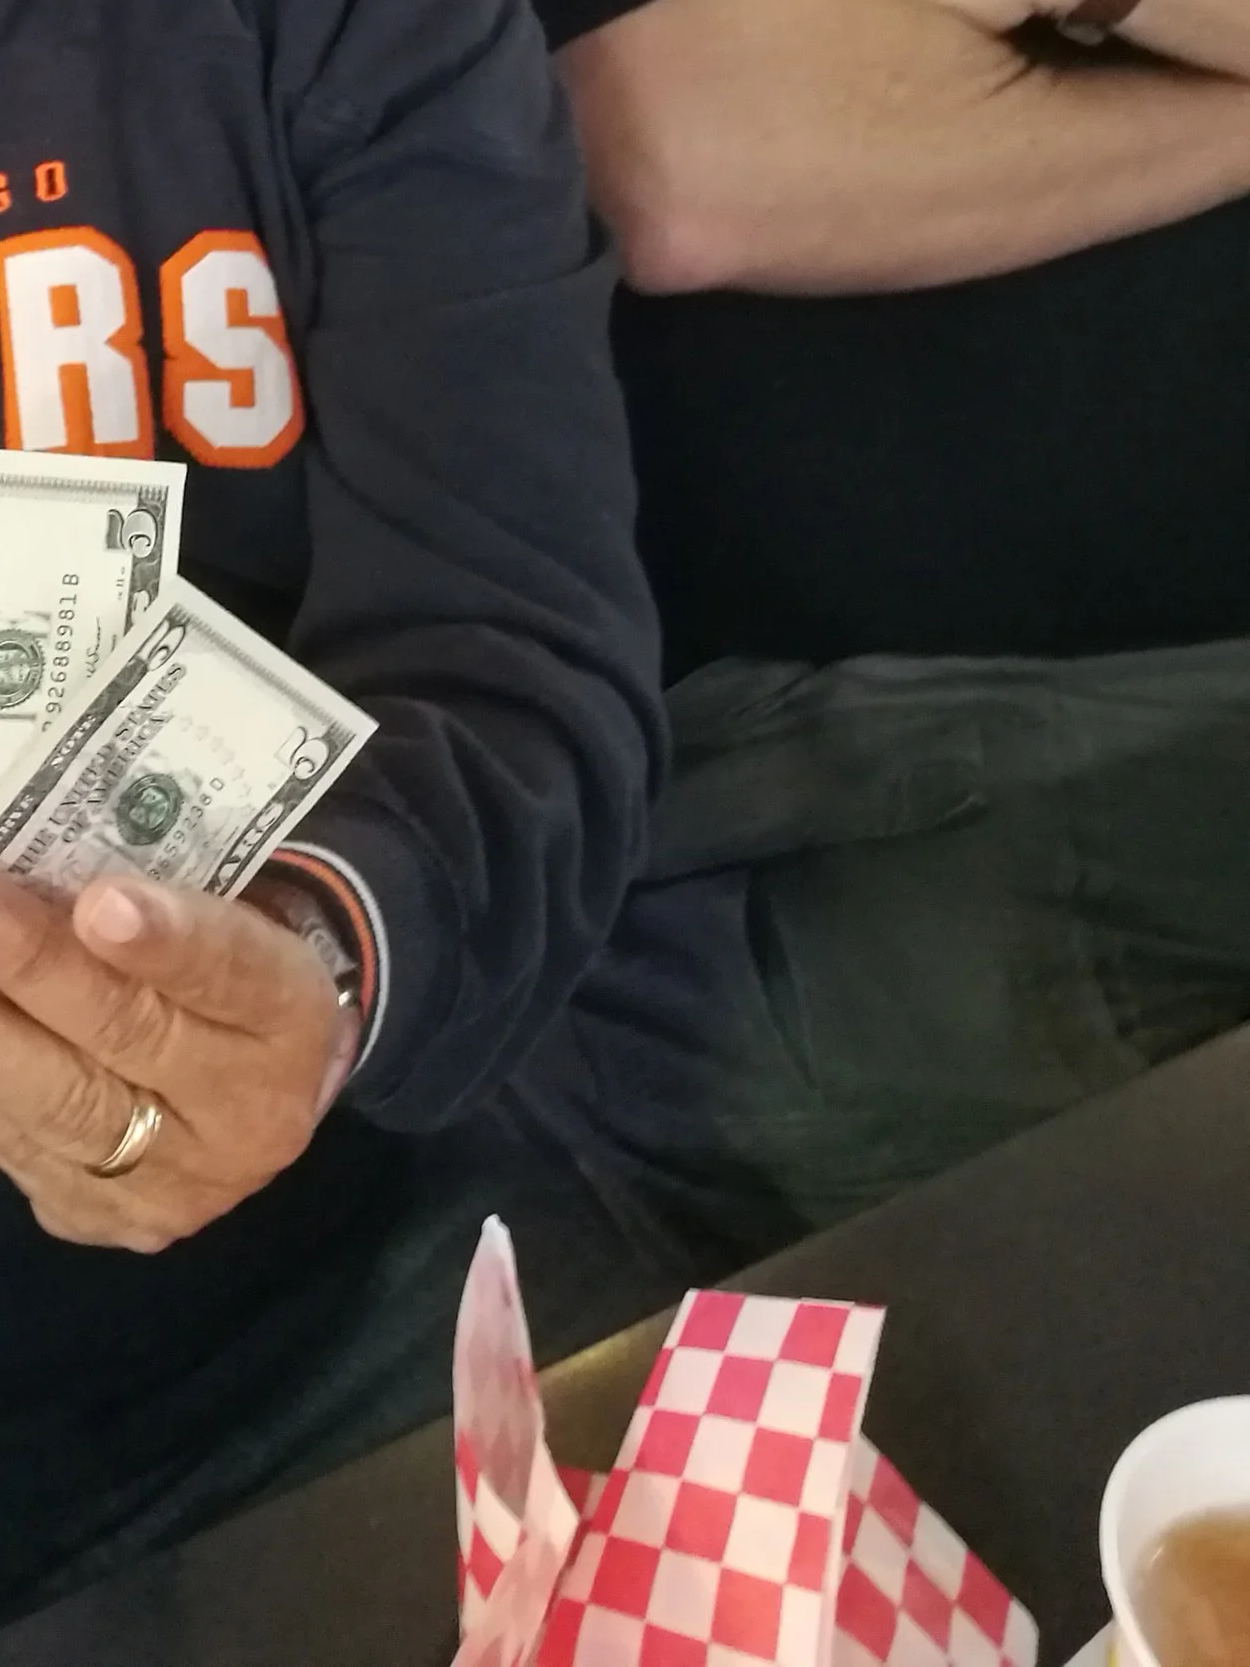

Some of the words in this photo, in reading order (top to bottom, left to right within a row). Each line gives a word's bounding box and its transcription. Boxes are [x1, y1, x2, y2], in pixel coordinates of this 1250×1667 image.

[105, 507, 157, 559] 5
[62, 571, 79, 586] B
[136, 620, 188, 672] 5
[46, 742, 123, 831] UNITED
[113, 658, 189, 746] STATES
[49, 713, 97, 769] NOTE
[82, 703, 174, 812] AMERICA
[280, 725, 330, 780] 5
